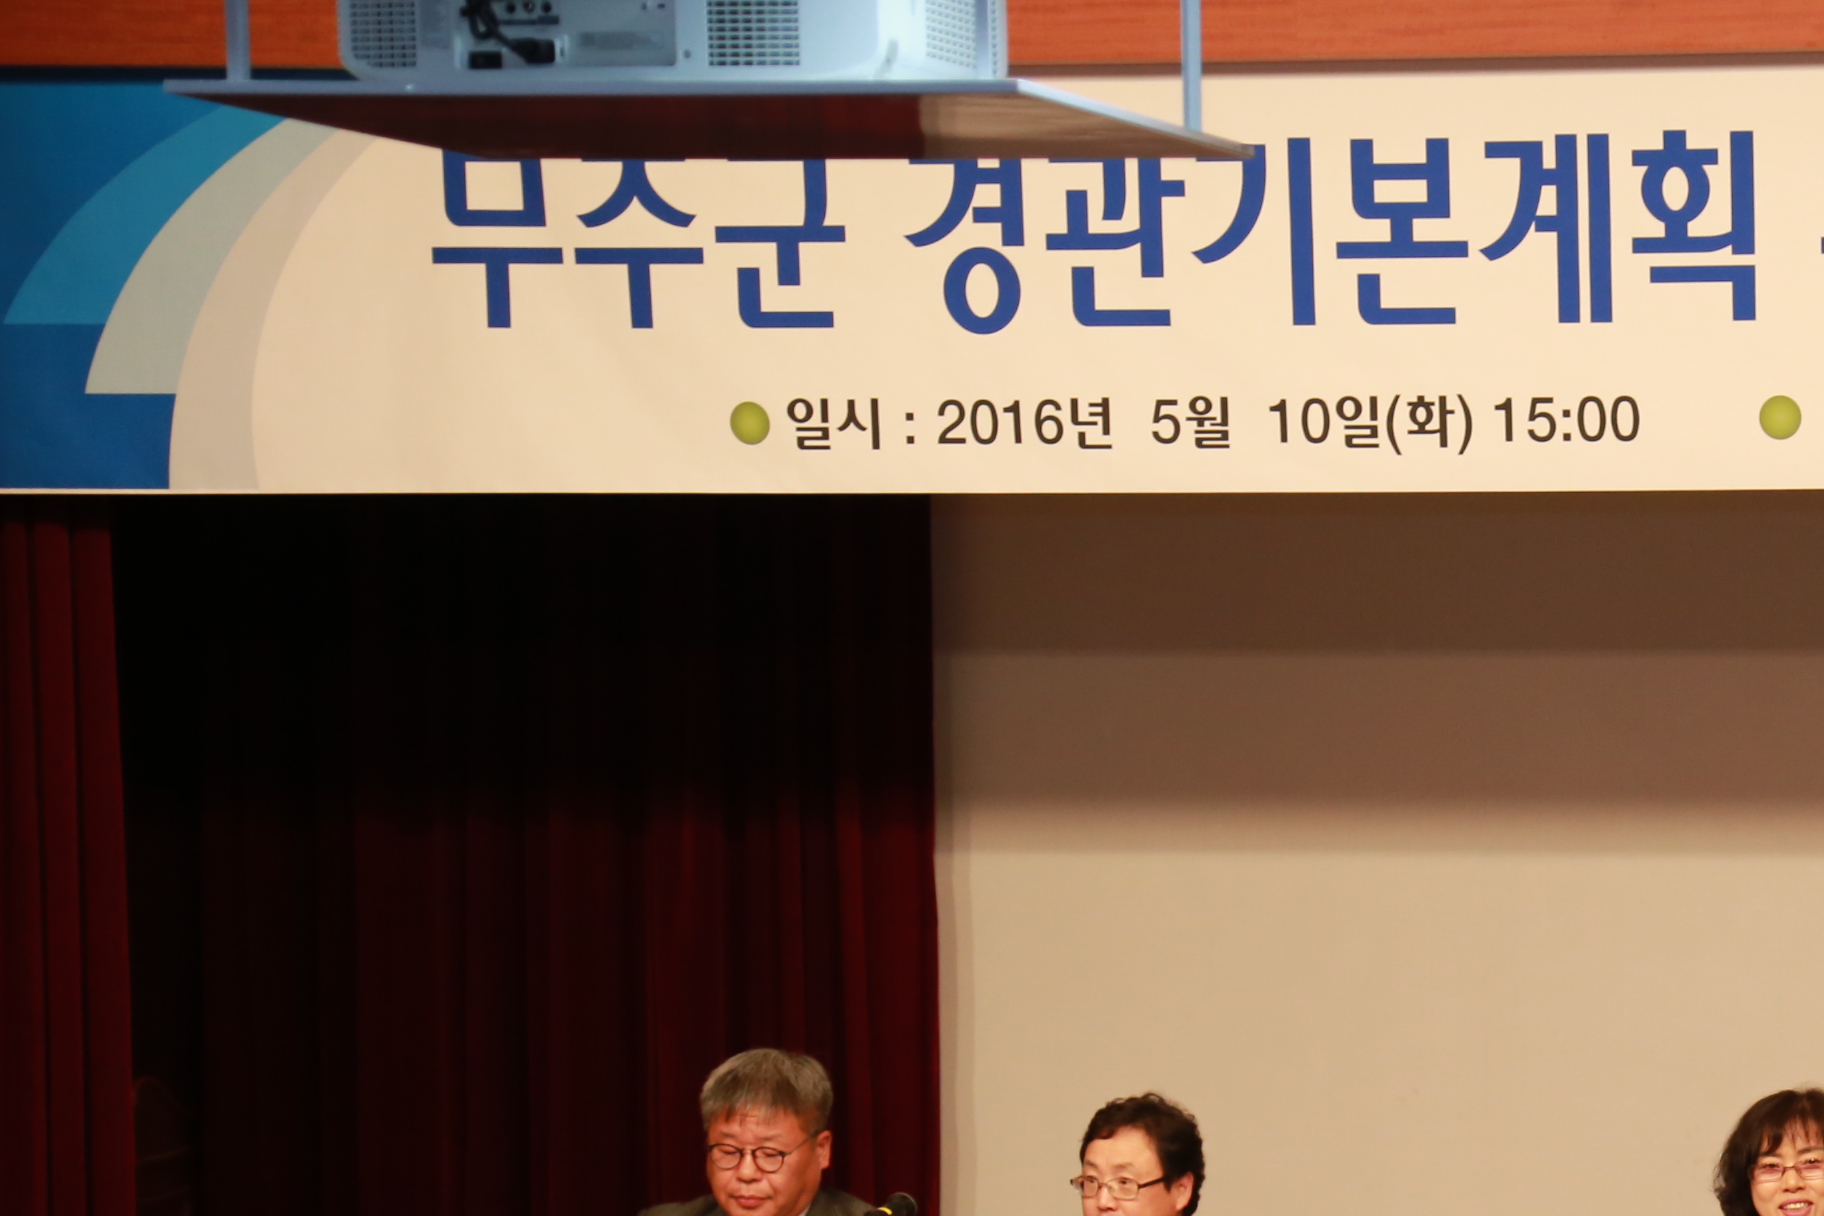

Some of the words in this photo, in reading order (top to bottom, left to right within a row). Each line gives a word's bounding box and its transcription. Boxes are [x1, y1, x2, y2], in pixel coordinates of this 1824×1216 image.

[431, 151, 847, 329] 무주군
[905, 129, 1757, 335] 경관기본계획
[786, 397, 881, 451] 일시
[937, 396, 1113, 450] 2016년
[1151, 395, 1231, 450] 5월
[1268, 393, 1473, 456] 10일(화)
[1494, 395, 1640, 443] 15:00
